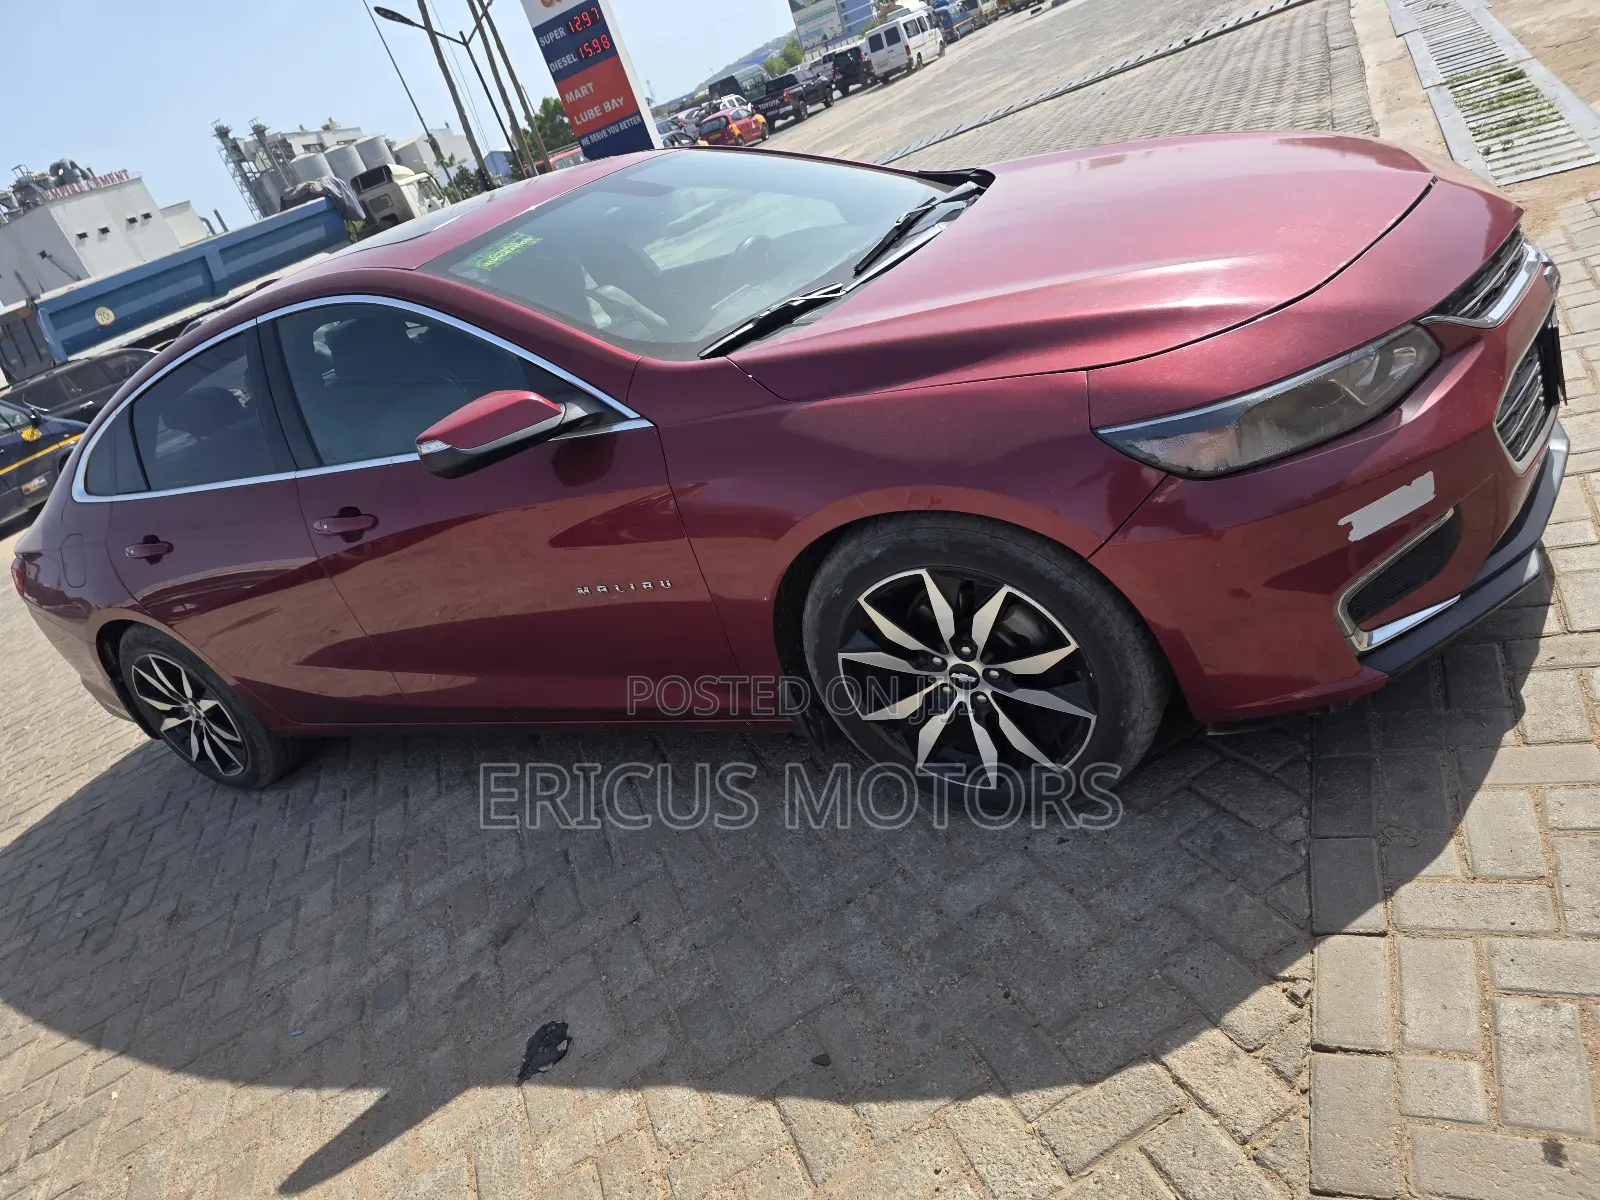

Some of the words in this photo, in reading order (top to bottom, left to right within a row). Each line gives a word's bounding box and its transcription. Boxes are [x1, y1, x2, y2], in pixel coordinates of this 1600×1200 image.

[539, 27, 566, 47] SUPER
[569, 8, 600, 33] 12.97
[549, 53, 578, 73] DIESEL
[579, 34, 611, 59] 15.98
[564, 82, 595, 104] MART
[758, 99, 780, 110] TOYOTA
[574, 104, 603, 126] LUBE
[603, 96, 625, 113] BAY
[581, 135, 591, 147] WE
[590, 128, 608, 144] SERVE
[608, 122, 620, 135] YOU
[619, 115, 642, 132] BETTER
[577, 579, 672, 596] MALIBU
